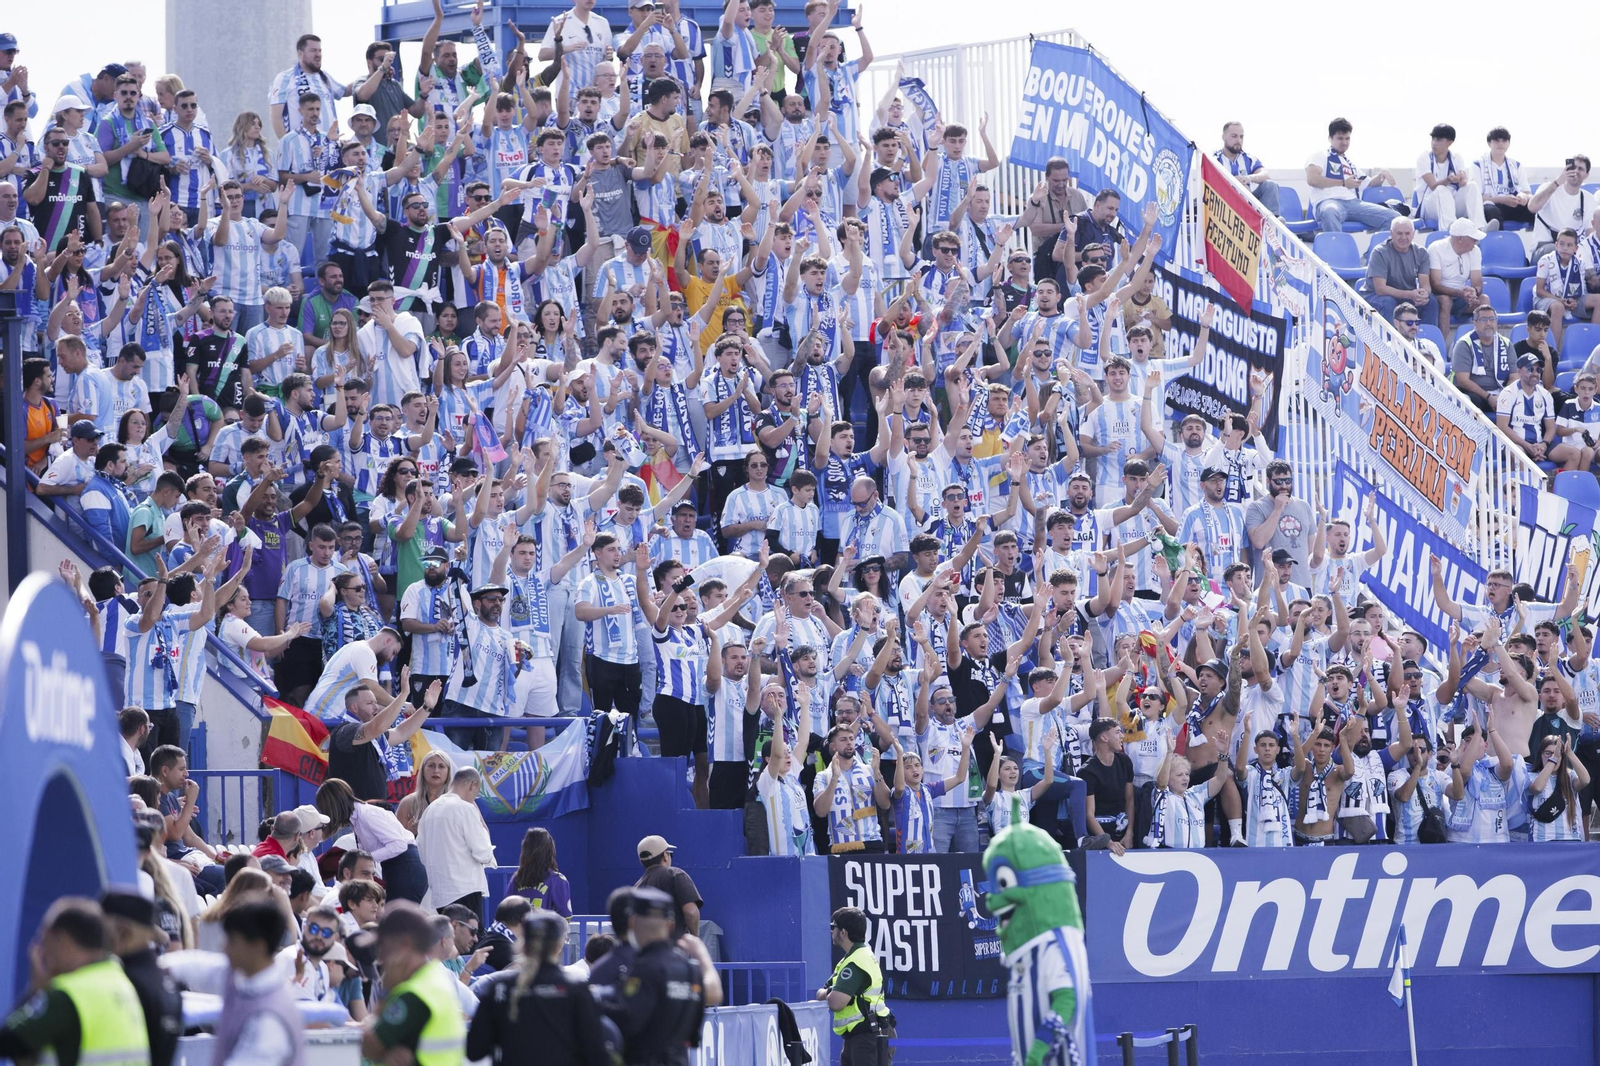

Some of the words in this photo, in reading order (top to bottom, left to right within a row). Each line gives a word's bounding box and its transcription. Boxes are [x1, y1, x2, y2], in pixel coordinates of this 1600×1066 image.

[1015, 100, 1054, 144] EN
[1202, 184, 1245, 242] CANILLAS
[1248, 230, 1260, 257] DE
[845, 860, 943, 917] SUPER
[1109, 851, 1600, 977] Ontime
